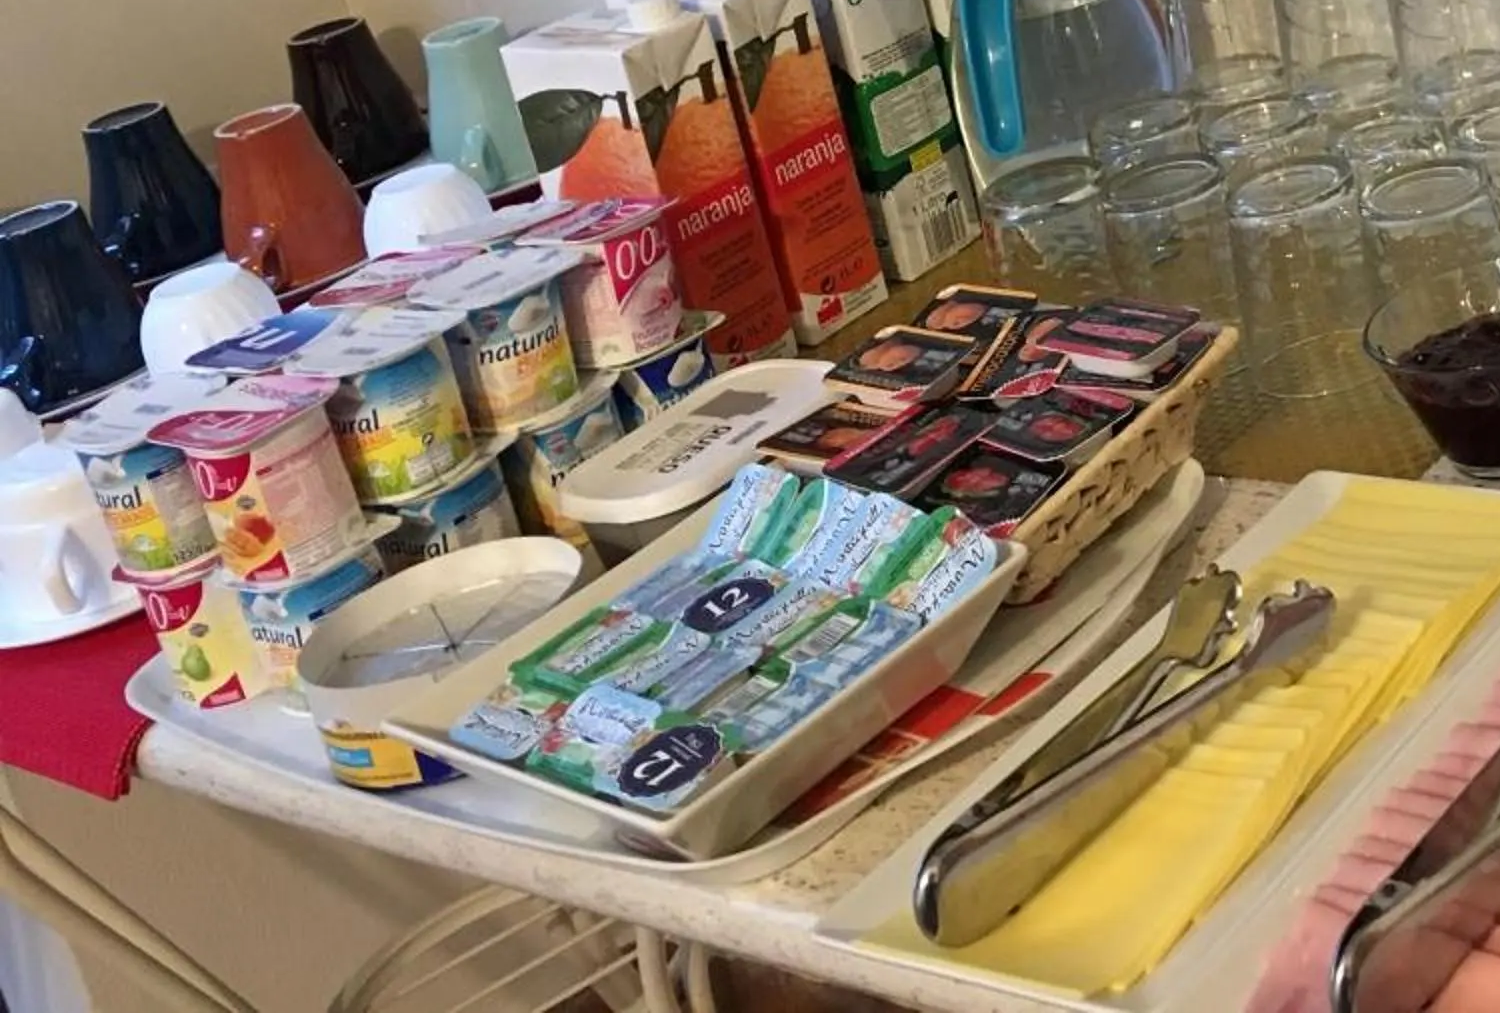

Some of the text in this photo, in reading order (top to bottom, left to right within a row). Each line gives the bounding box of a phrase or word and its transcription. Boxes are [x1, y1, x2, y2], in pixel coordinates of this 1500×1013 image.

[774, 131, 847, 187] naranja
[677, 183, 754, 240] naranja
[479, 315, 560, 366] natural
[703, 587, 749, 618] 12
[633, 750, 685, 787] 12
